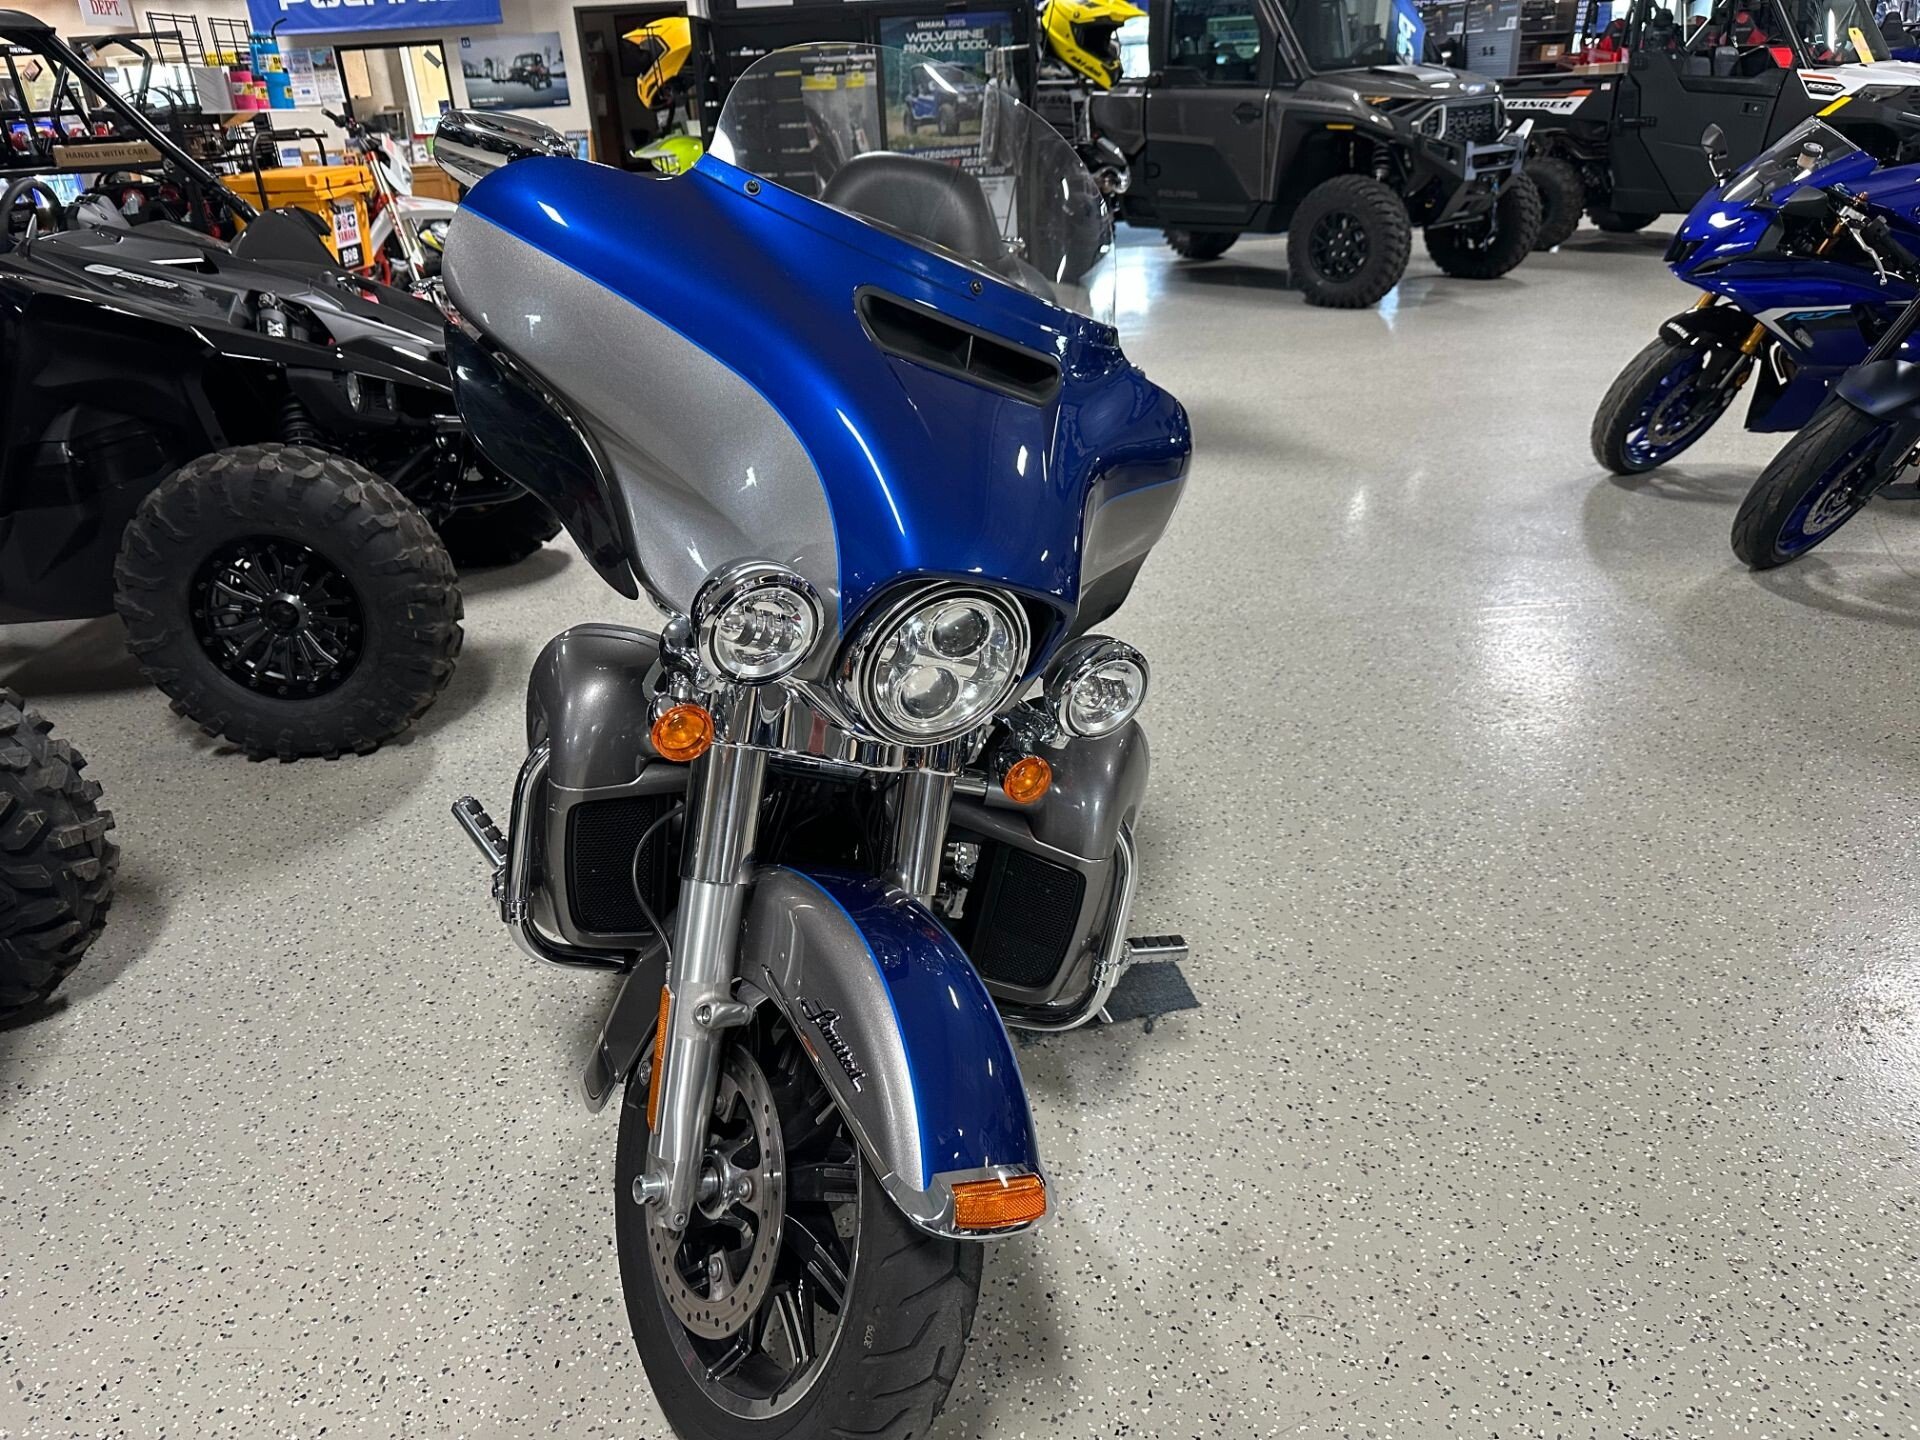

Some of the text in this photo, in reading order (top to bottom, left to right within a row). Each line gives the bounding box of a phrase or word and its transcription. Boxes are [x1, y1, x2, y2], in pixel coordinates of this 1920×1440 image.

[916, 18, 967, 29] YAMAHA 2025
[905, 28, 985, 43] WOLVERINE
[903, 42, 954, 54] RMAX4
[1807, 82, 1844, 92] 1000
[1506, 100, 1573, 109] RANGER
[1448, 112, 1492, 128] POLARIS
[64, 147, 149, 160] HANDLE WITH CARE
[800, 997, 867, 1093] Limited
